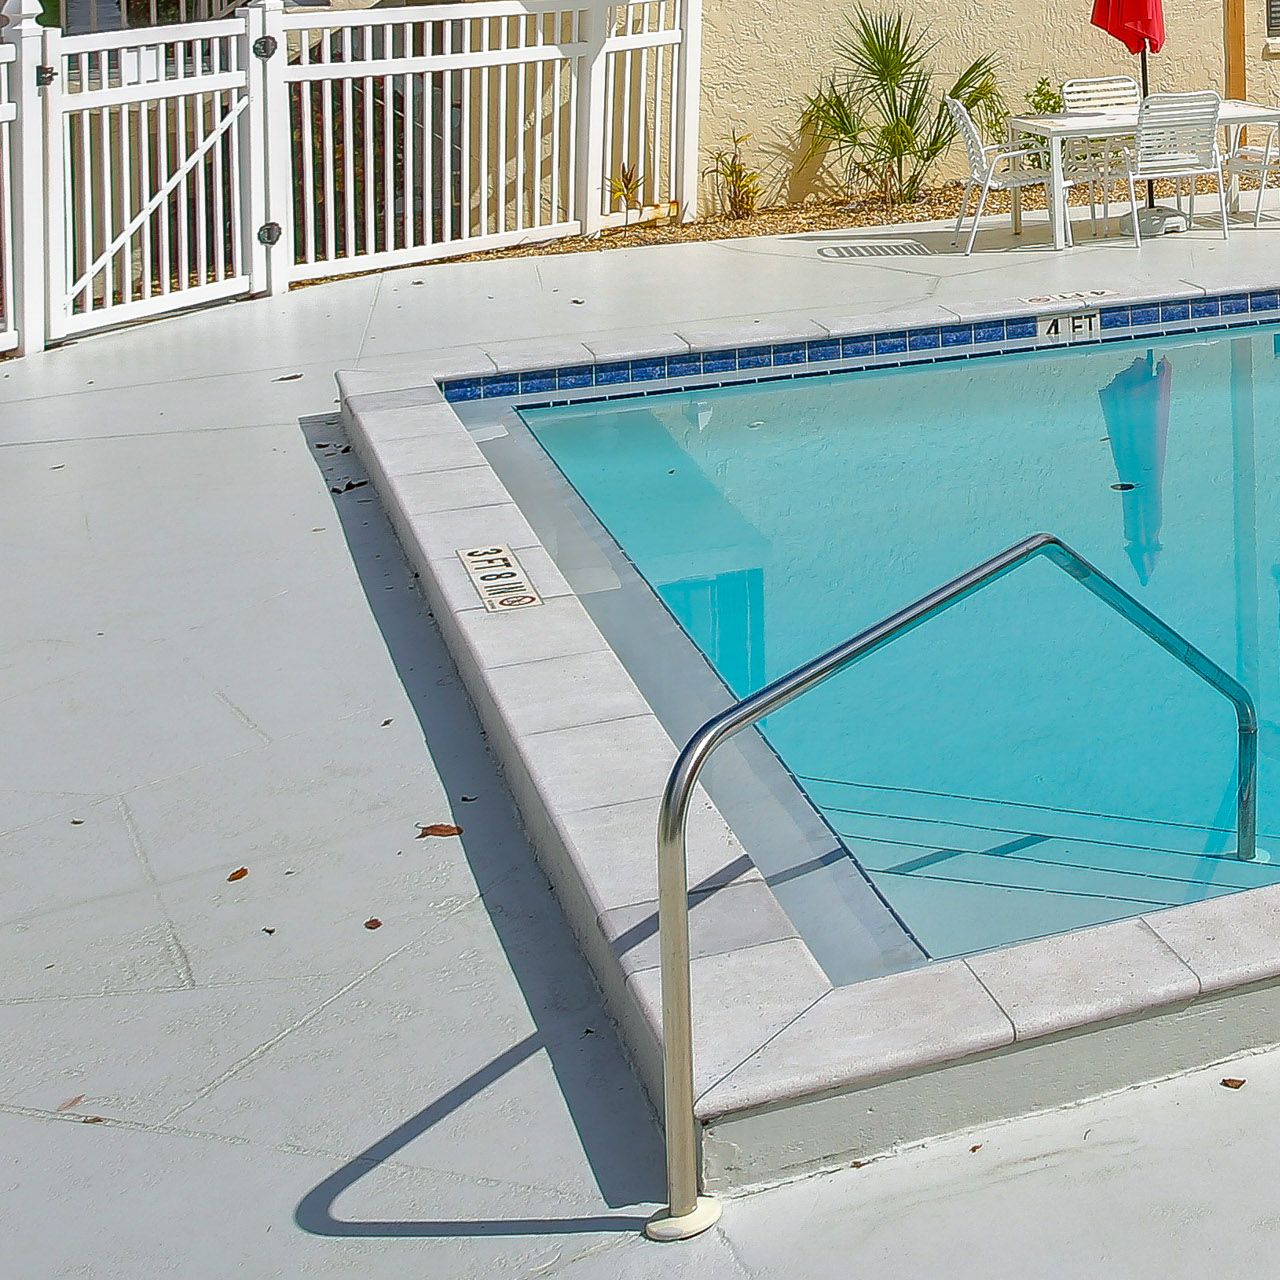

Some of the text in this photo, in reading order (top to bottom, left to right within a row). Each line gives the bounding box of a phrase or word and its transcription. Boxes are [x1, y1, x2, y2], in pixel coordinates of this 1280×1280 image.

[1046, 314, 1096, 335] 4 FT
[467, 548, 526, 595] 3 FT 8 IN
